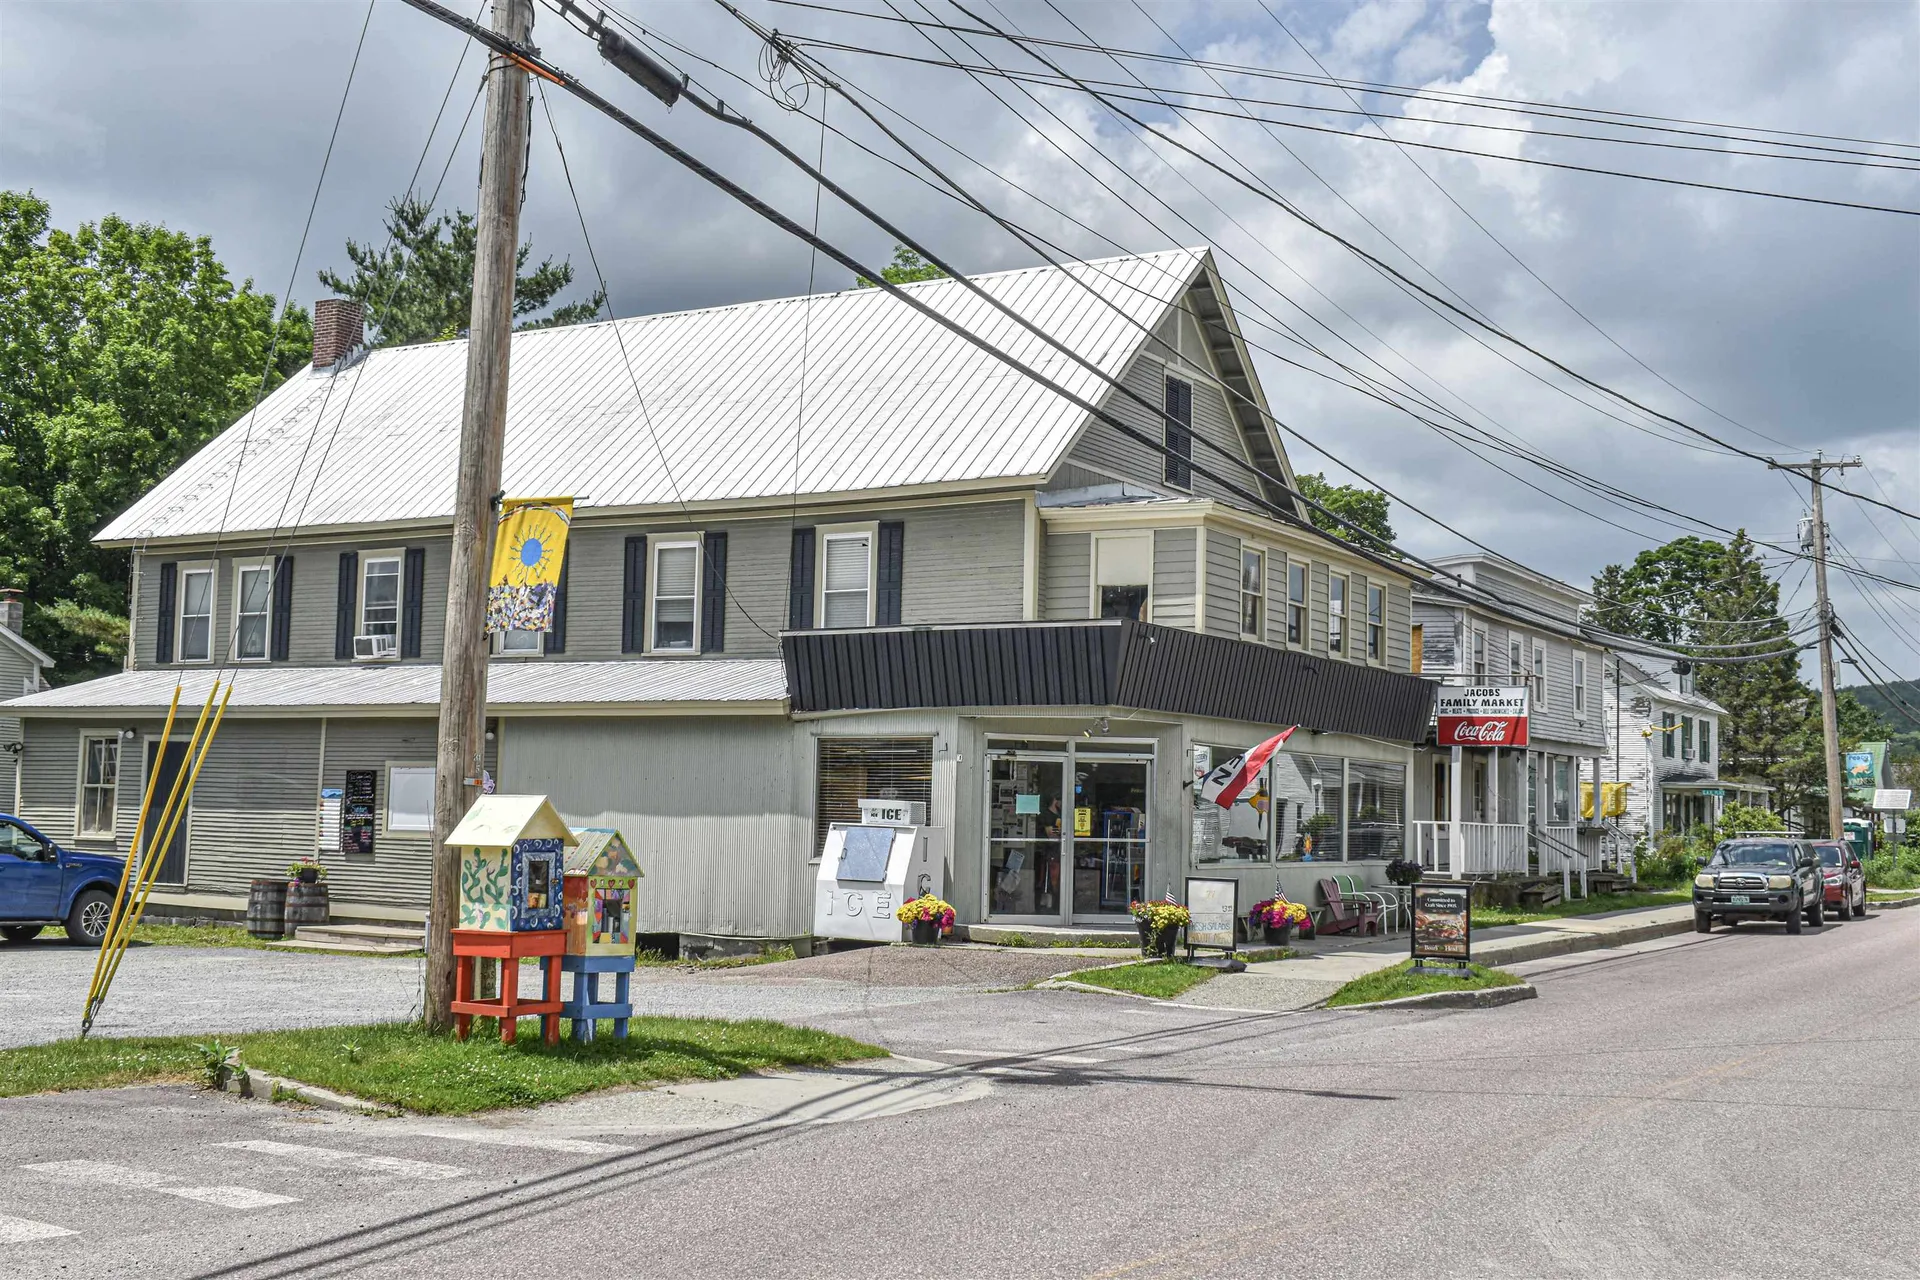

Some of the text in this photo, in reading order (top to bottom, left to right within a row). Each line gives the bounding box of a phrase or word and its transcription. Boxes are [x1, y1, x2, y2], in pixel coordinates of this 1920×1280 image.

[1464, 688, 1500, 697] JACOBS
[1440, 698, 1524, 707] FAMILY MARKET
[1454, 721, 1508, 741] Coca-Cola
[881, 808, 902, 821] ICE
[825, 889, 892, 920] ICE
[1207, 922, 1231, 931] SALADS
